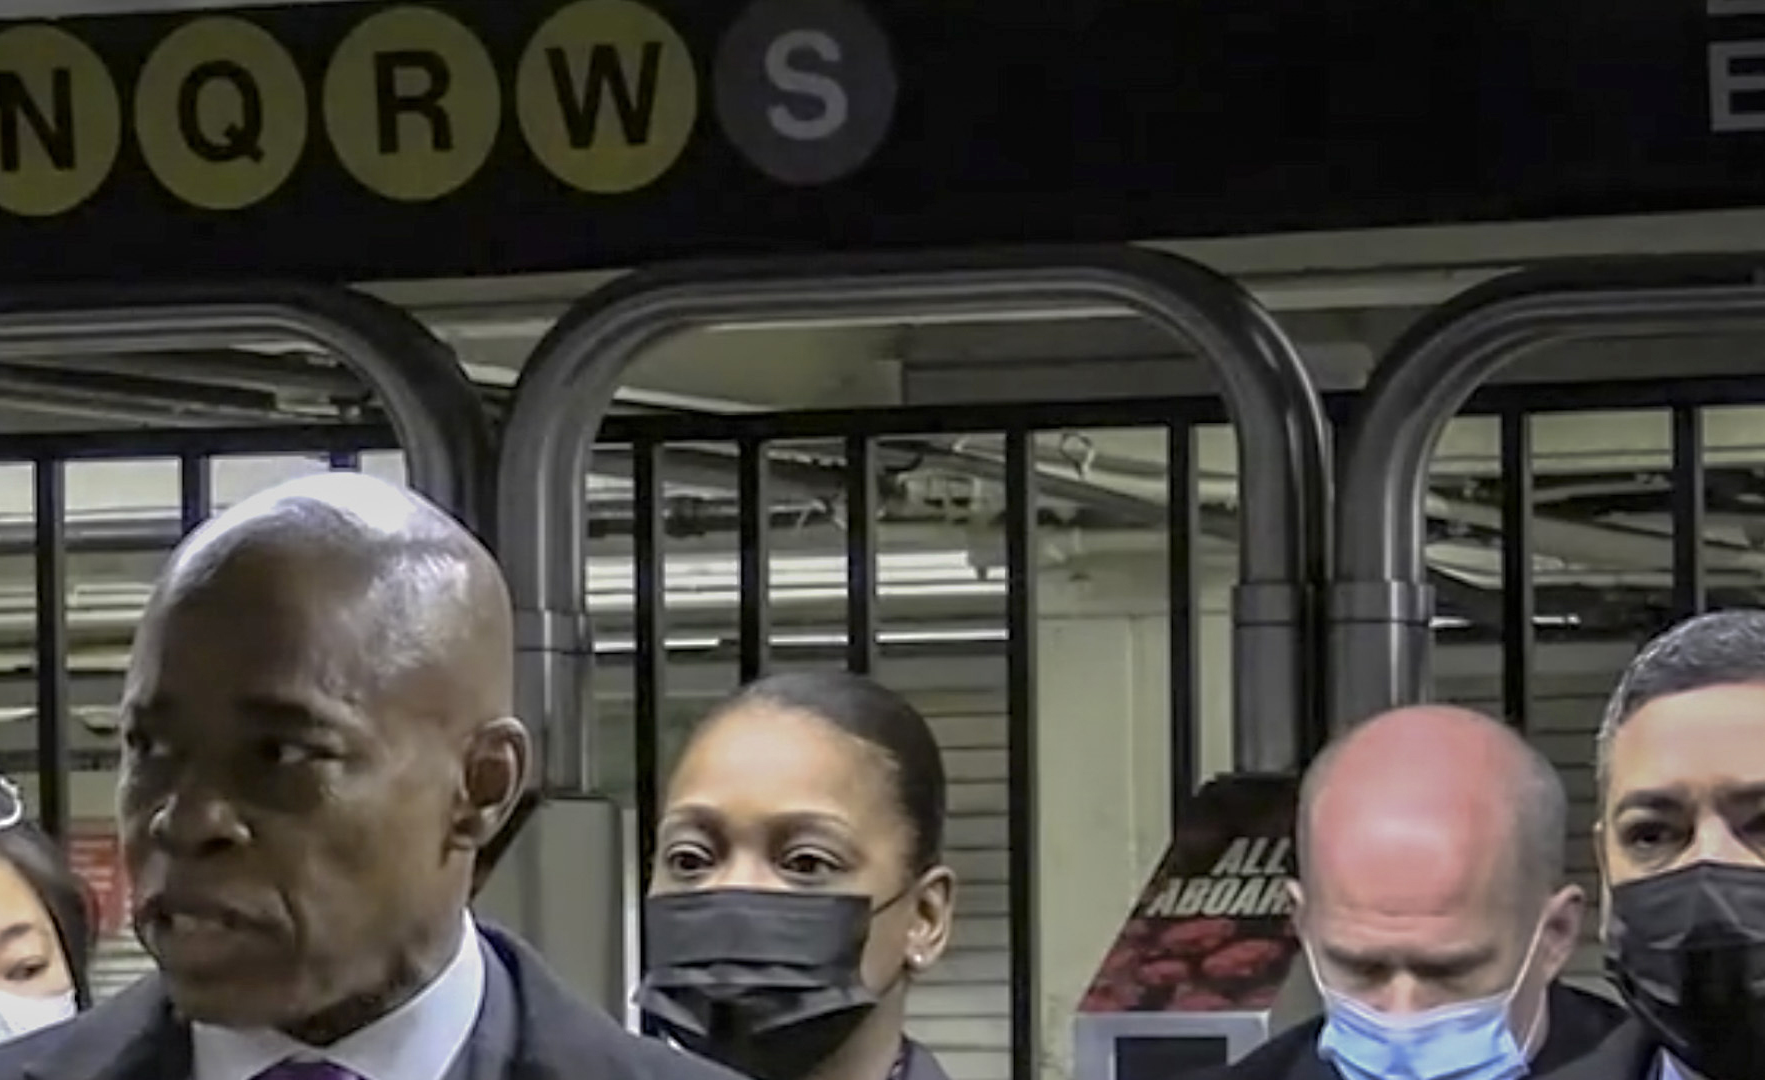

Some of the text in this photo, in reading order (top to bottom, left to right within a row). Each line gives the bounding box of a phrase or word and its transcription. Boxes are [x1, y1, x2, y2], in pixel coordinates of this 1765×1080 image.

[177, 59, 265, 165] Q
[372, 49, 455, 155] R
[545, 41, 663, 150] W
[764, 29, 849, 142] S
[1706, 41, 1765, 132] E
[1210, 836, 1292, 876] ALL
[1144, 876, 1297, 919] ABOAR
